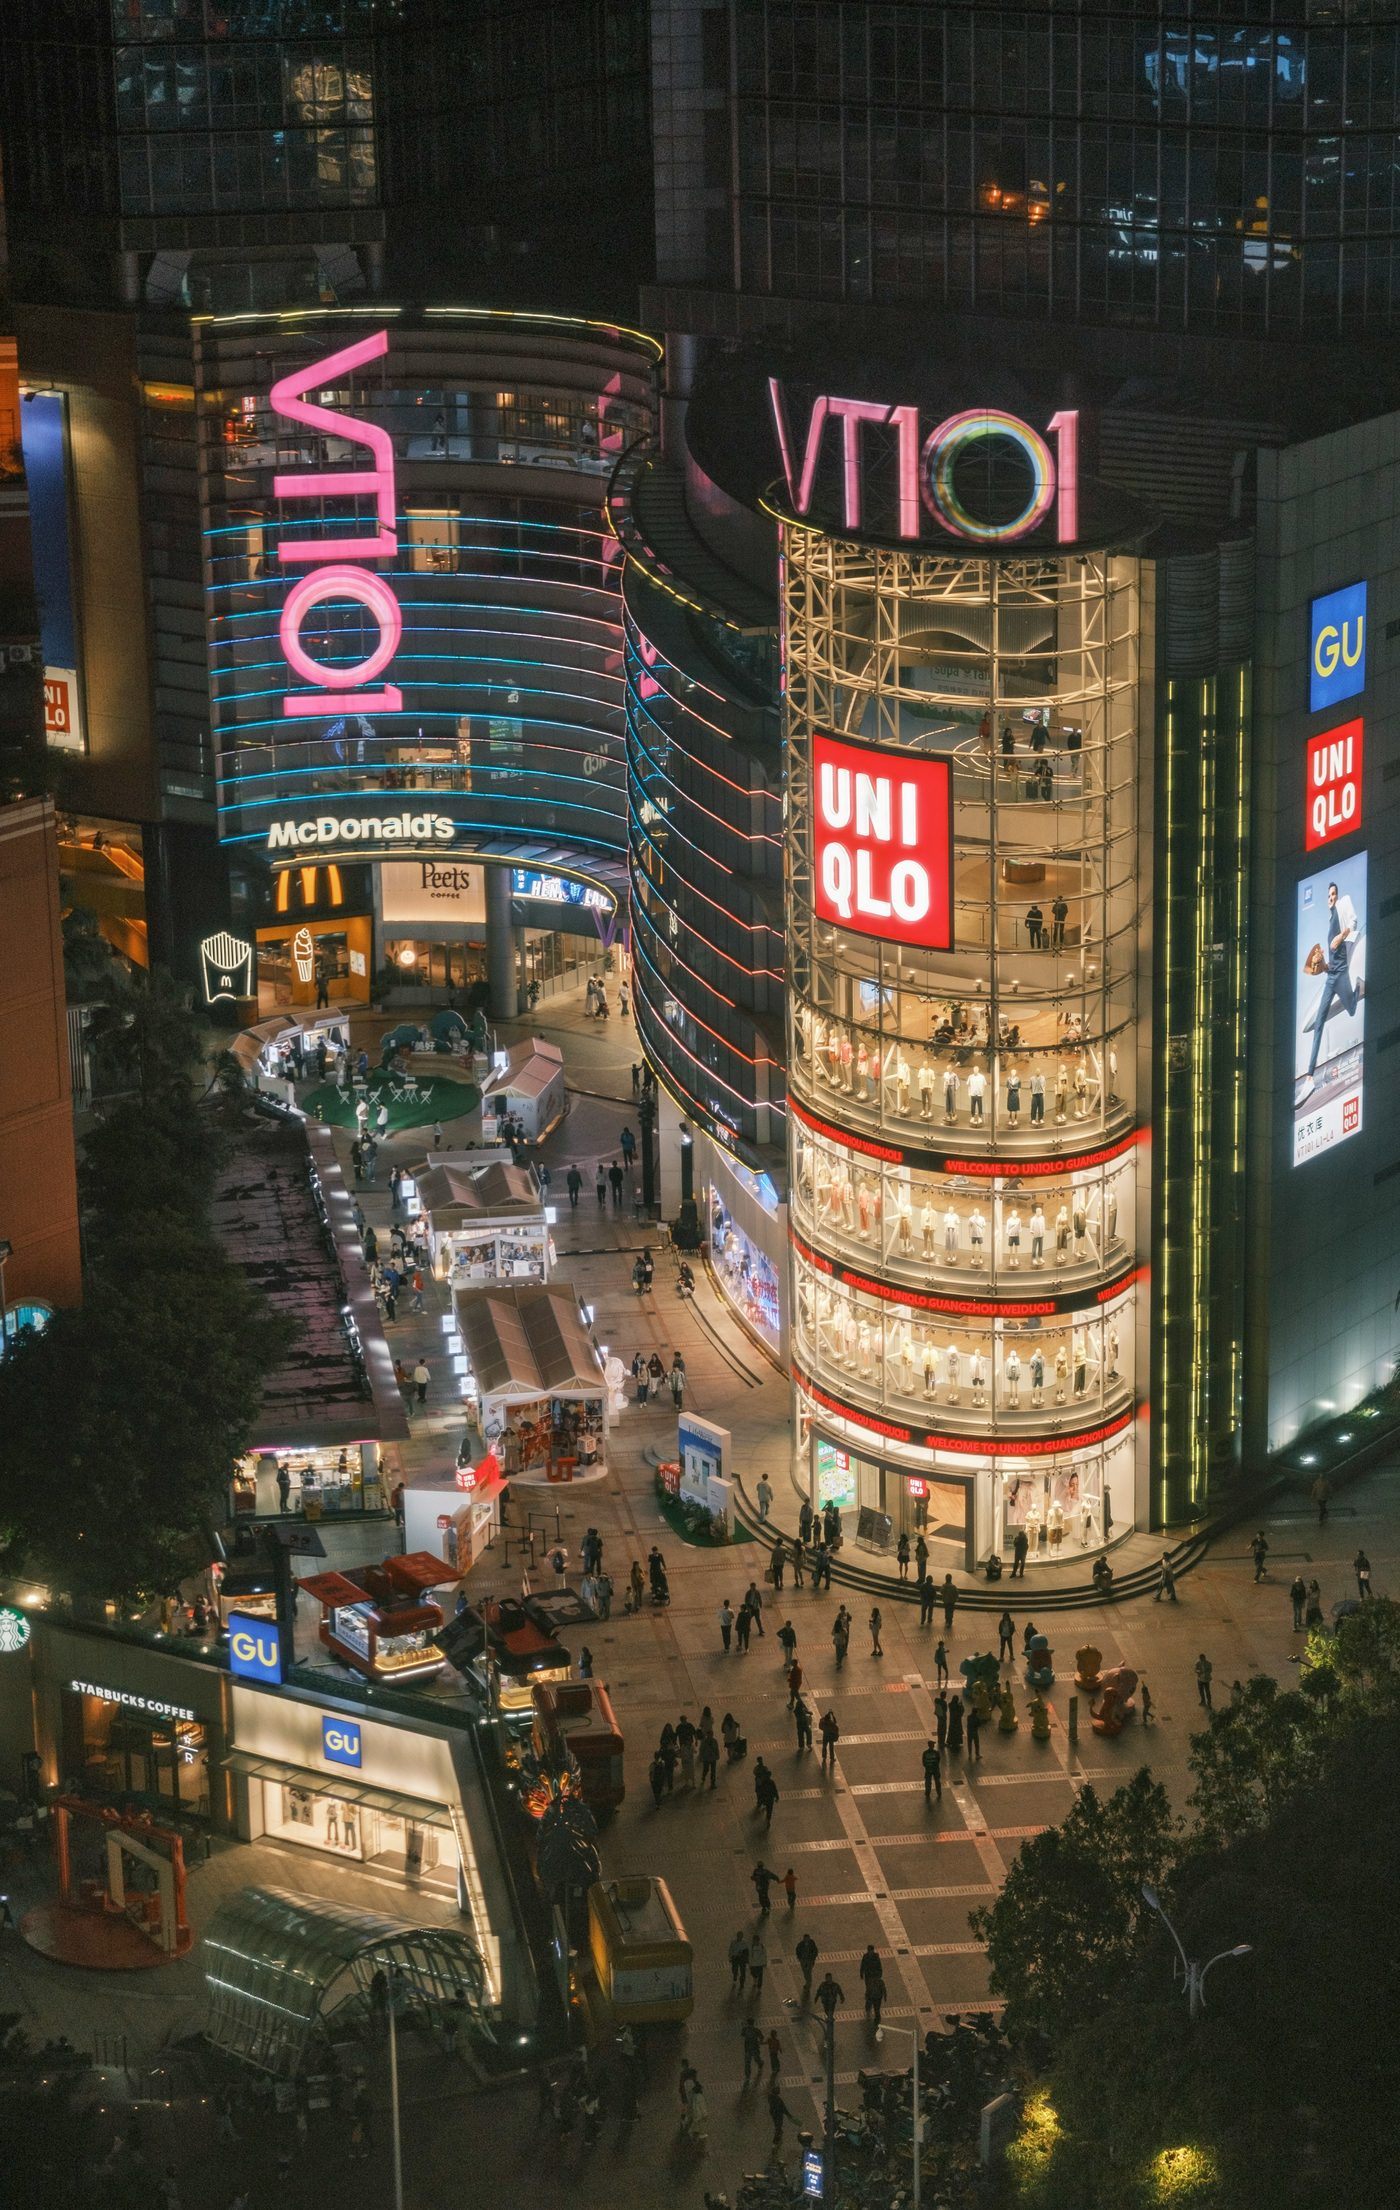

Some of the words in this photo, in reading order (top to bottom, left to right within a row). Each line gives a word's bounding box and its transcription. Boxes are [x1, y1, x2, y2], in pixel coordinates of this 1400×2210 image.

[769, 377, 1079, 543] VT101
[270, 330, 403, 716] VT101
[1314, 615, 1363, 677] GU
[44, 685, 62, 704] NI
[45, 706, 66, 726] LO
[1313, 736, 1353, 787] UNI
[821, 762, 917, 846] UNI
[1312, 782, 1356, 837] QLO
[268, 813, 455, 848] McDonald's
[421, 862, 470, 889] Peet's
[822, 842, 930, 922] QLO
[1344, 1100, 1357, 1117] UNI
[1344, 1114, 1358, 1129] QLO
[947, 1160, 1001, 1175] WELCOME
[1004, 1163, 1020, 1175] TO
[1022, 1160, 1065, 1174] UNIQLO
[1065, 1142, 1119, 1170] GUANGZHOU
[842, 1271, 880, 1293] WELCOME
[879, 1285, 892, 1297] TO
[891, 1288, 927, 1307] UNIQLO
[927, 1298, 998, 1314] GUANGZHOU
[1000, 1302, 1056, 1315] WEIDUOLI
[869, 1417, 911, 1441] WEIDUOLI
[927, 1434, 980, 1451] WELCOME
[982, 1441, 997, 1453] TO
[999, 1441, 1043, 1454] UNIQLO
[1043, 1430, 1105, 1451] GUANGZHOU
[463, 1474, 475, 1482] UNI
[546, 1456, 577, 1483] UT
[464, 1480, 476, 1488] QLO
[909, 1479, 923, 1488] UNI
[910, 1486, 924, 1495] QLO
[232, 1632, 278, 1667] GU
[71, 1680, 145, 1708] STARBUCKS
[147, 1700, 194, 1721] COFFEE
[325, 1730, 359, 1755] GU
